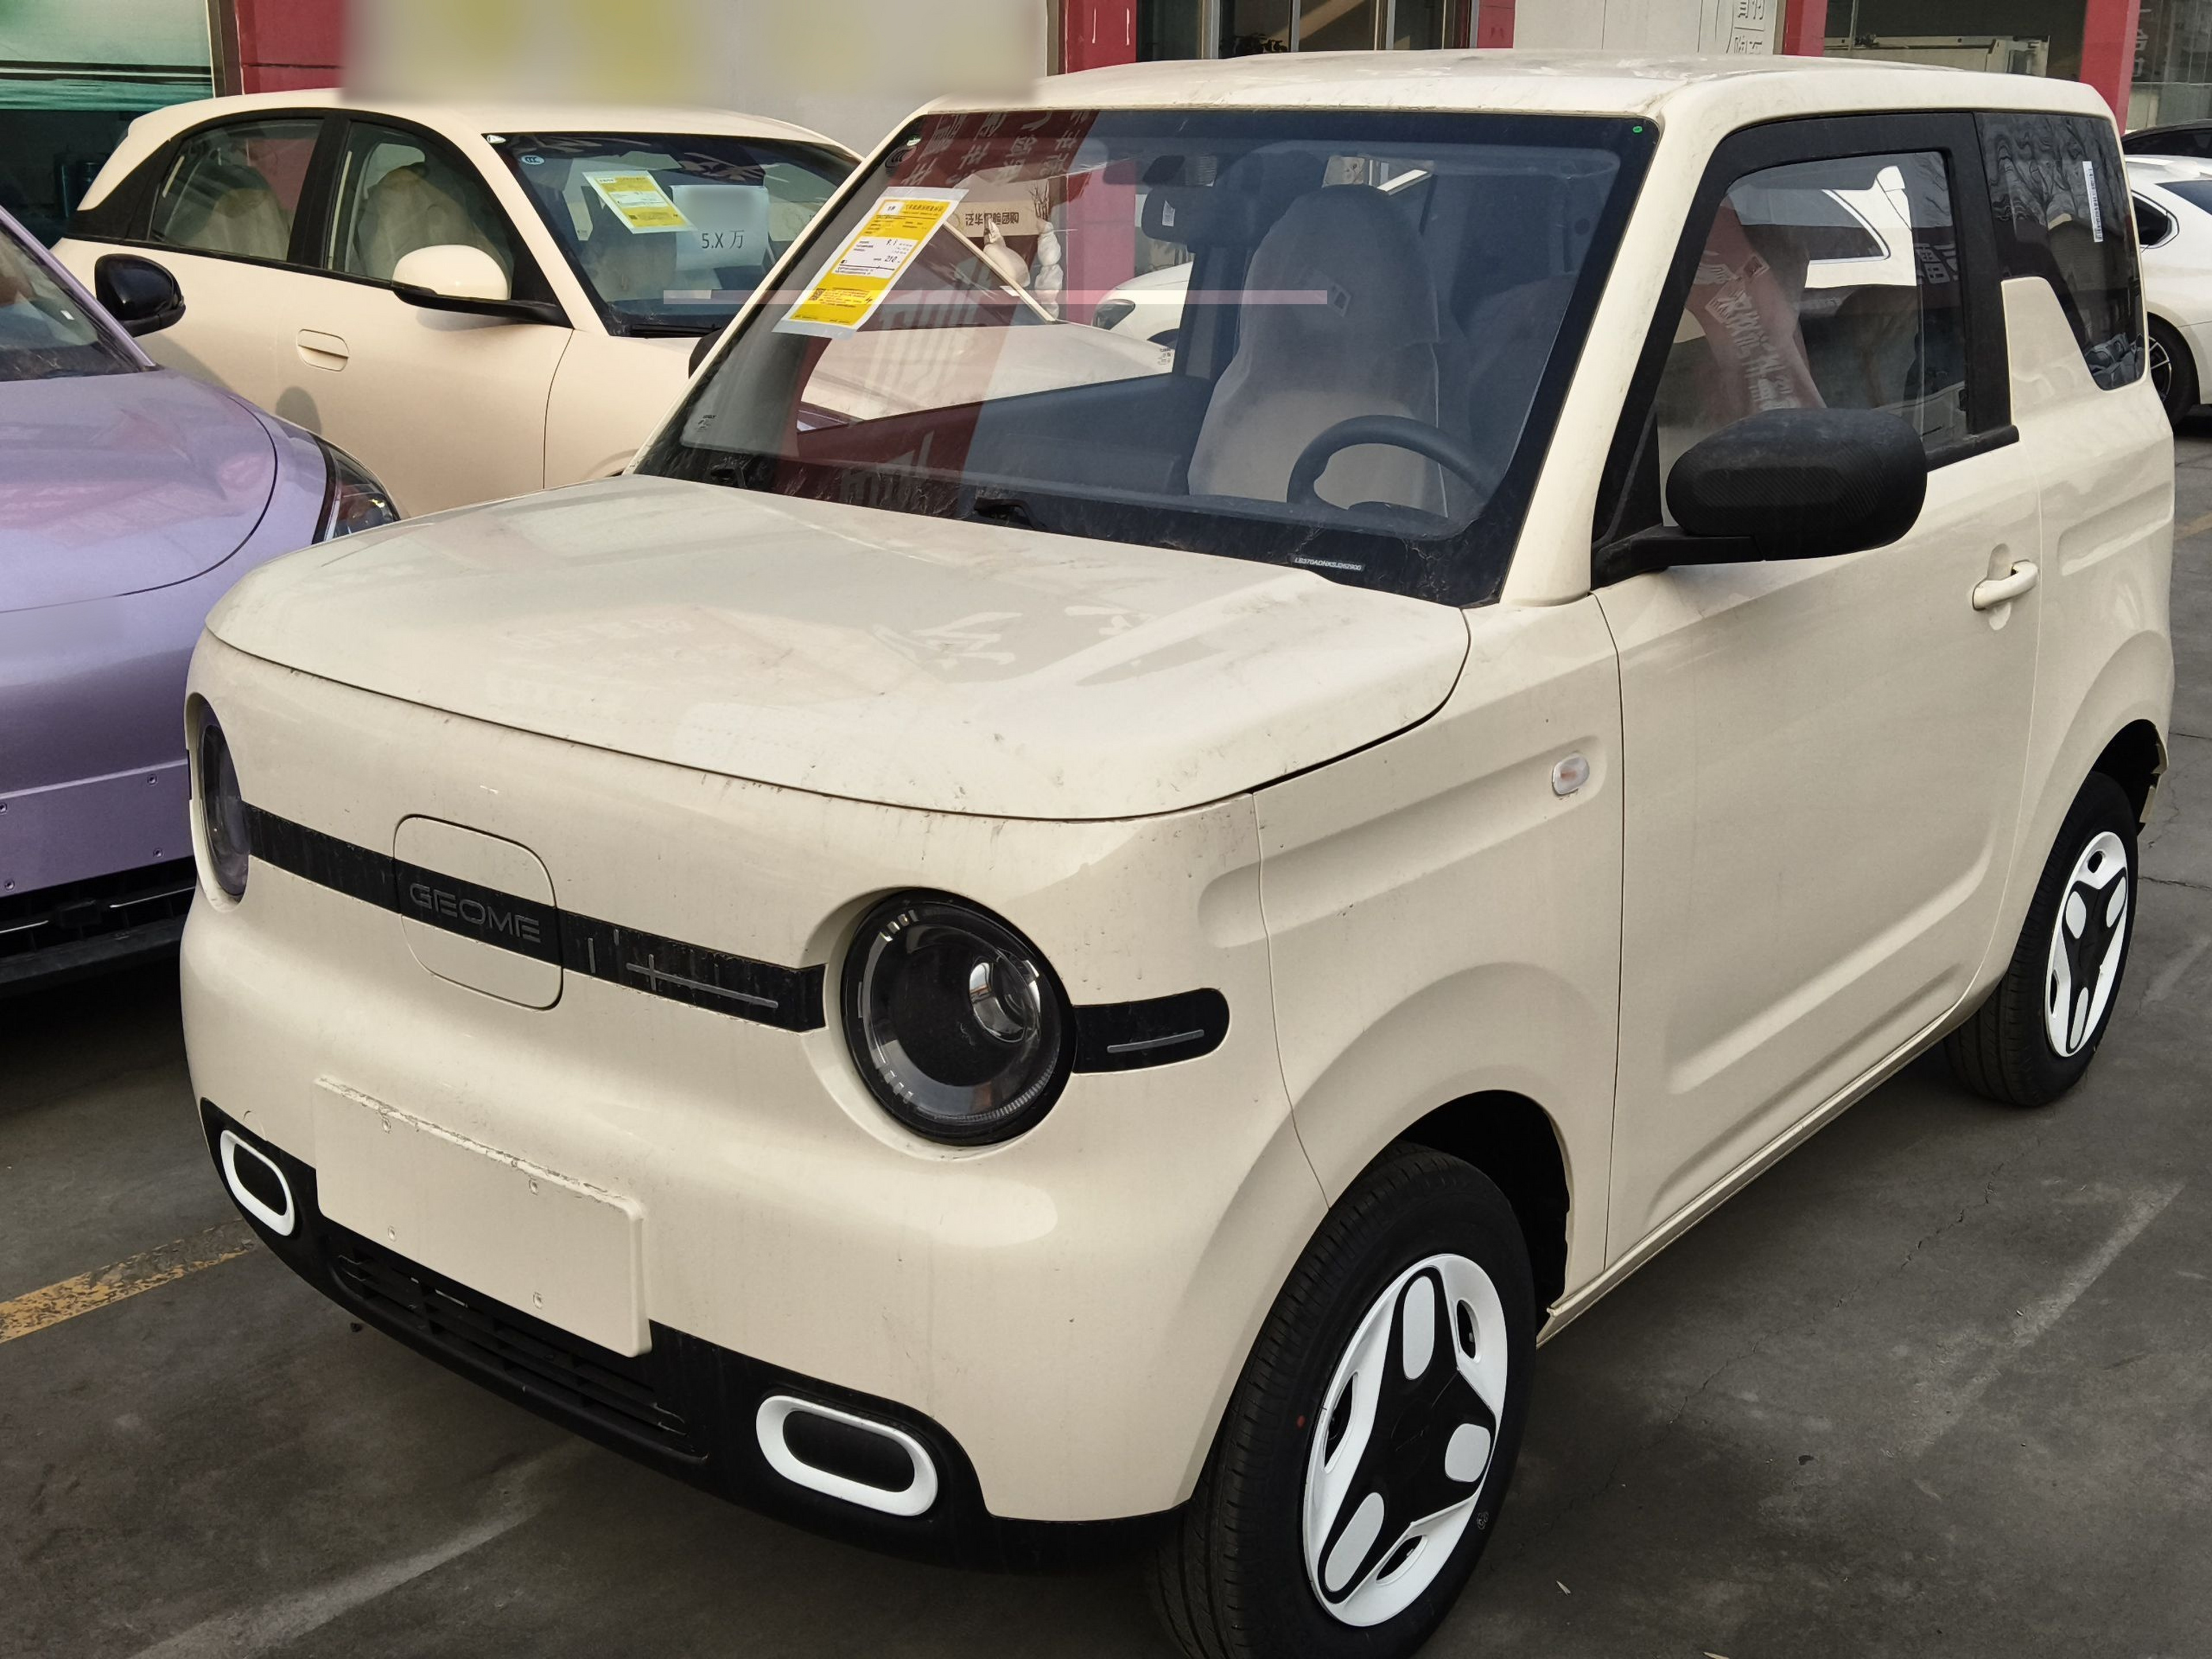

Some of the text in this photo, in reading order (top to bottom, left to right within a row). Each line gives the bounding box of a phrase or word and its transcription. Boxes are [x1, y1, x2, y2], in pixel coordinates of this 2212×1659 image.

[702, 230, 744, 249] 5.X 万
[410, 882, 541, 944] GEOME
